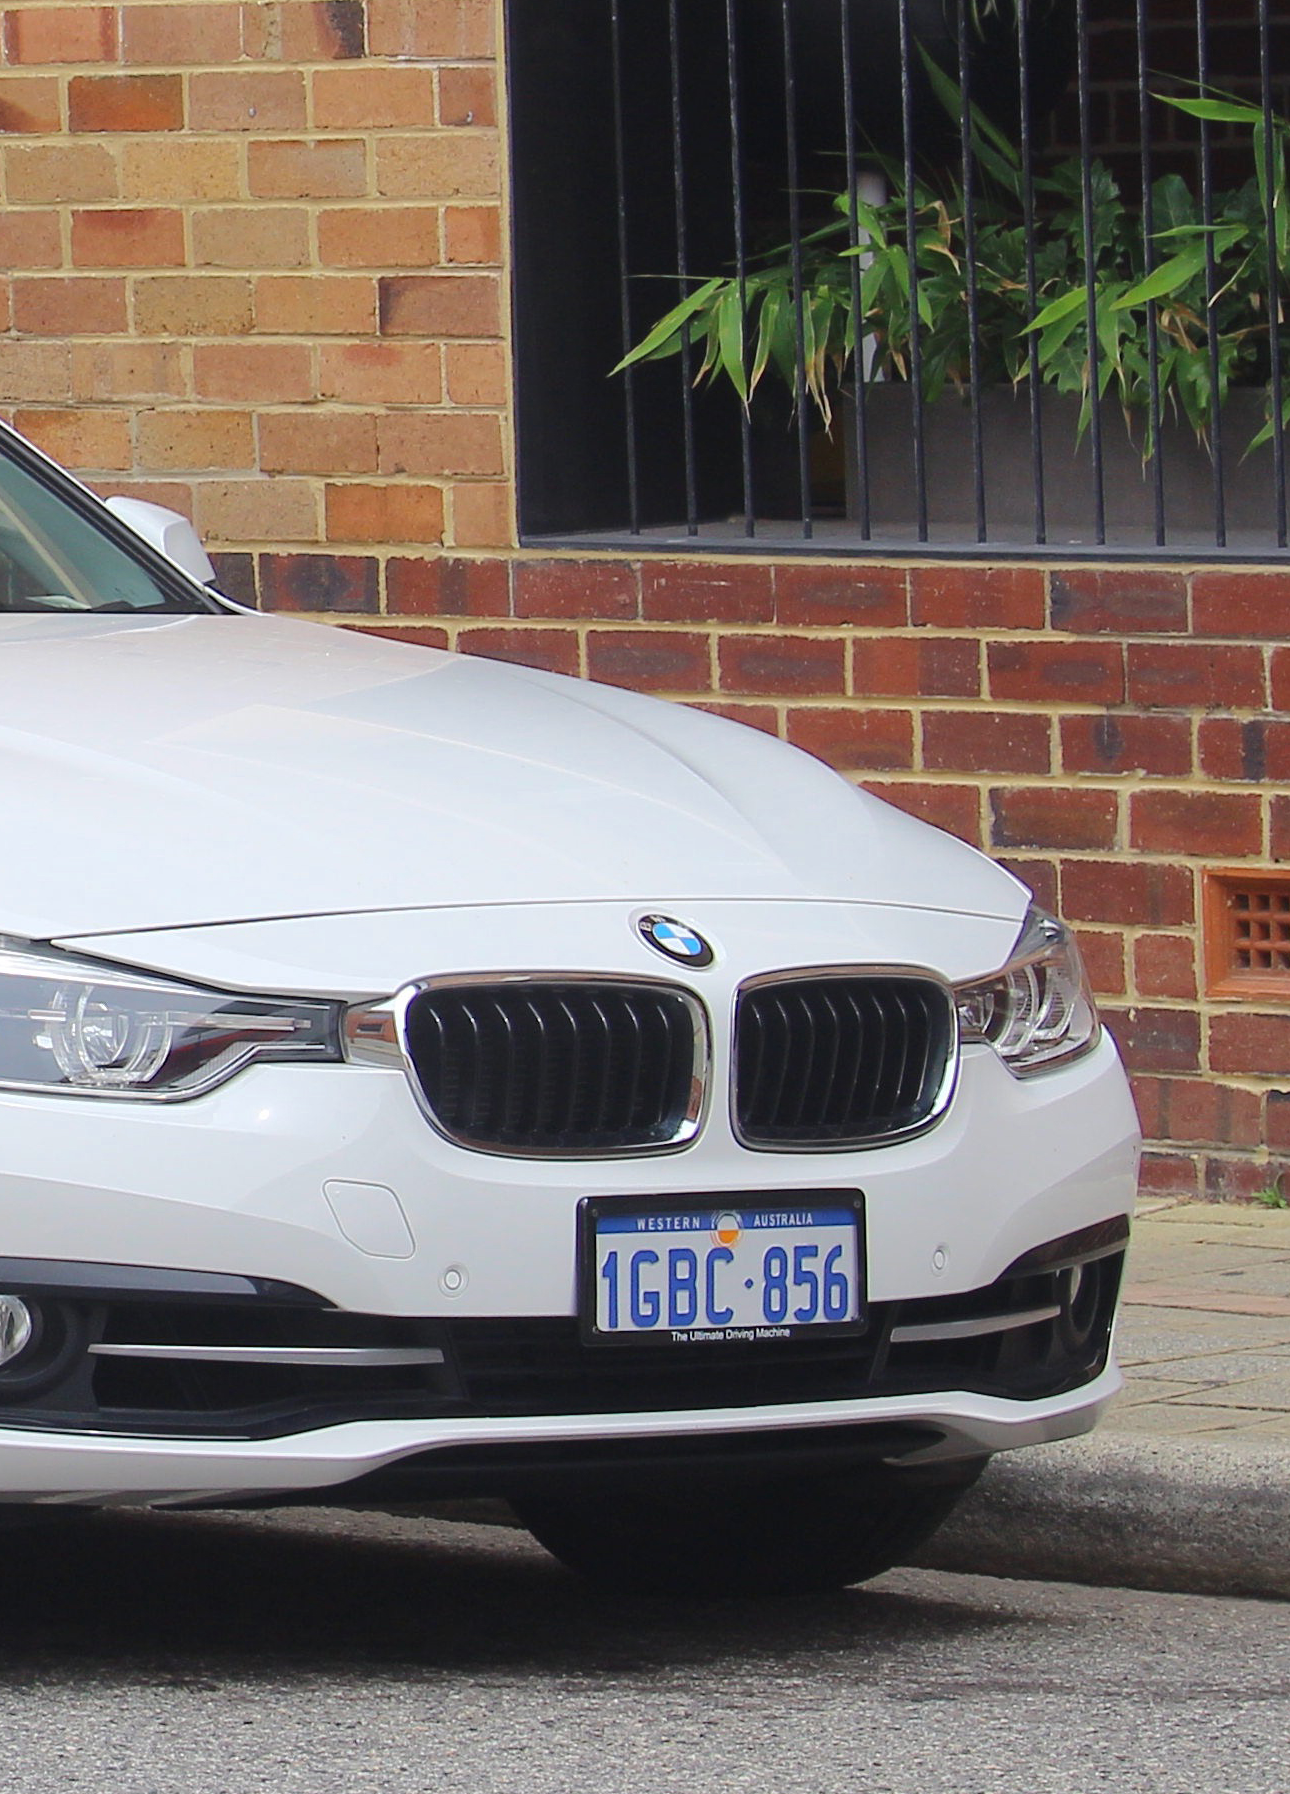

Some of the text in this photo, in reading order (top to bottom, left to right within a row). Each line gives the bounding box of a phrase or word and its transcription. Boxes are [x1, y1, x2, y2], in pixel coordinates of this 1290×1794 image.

[636, 1213, 814, 1231] WESTERN AUSTRALIA
[671, 1327, 790, 1341] The Ultimate Driving Machine
